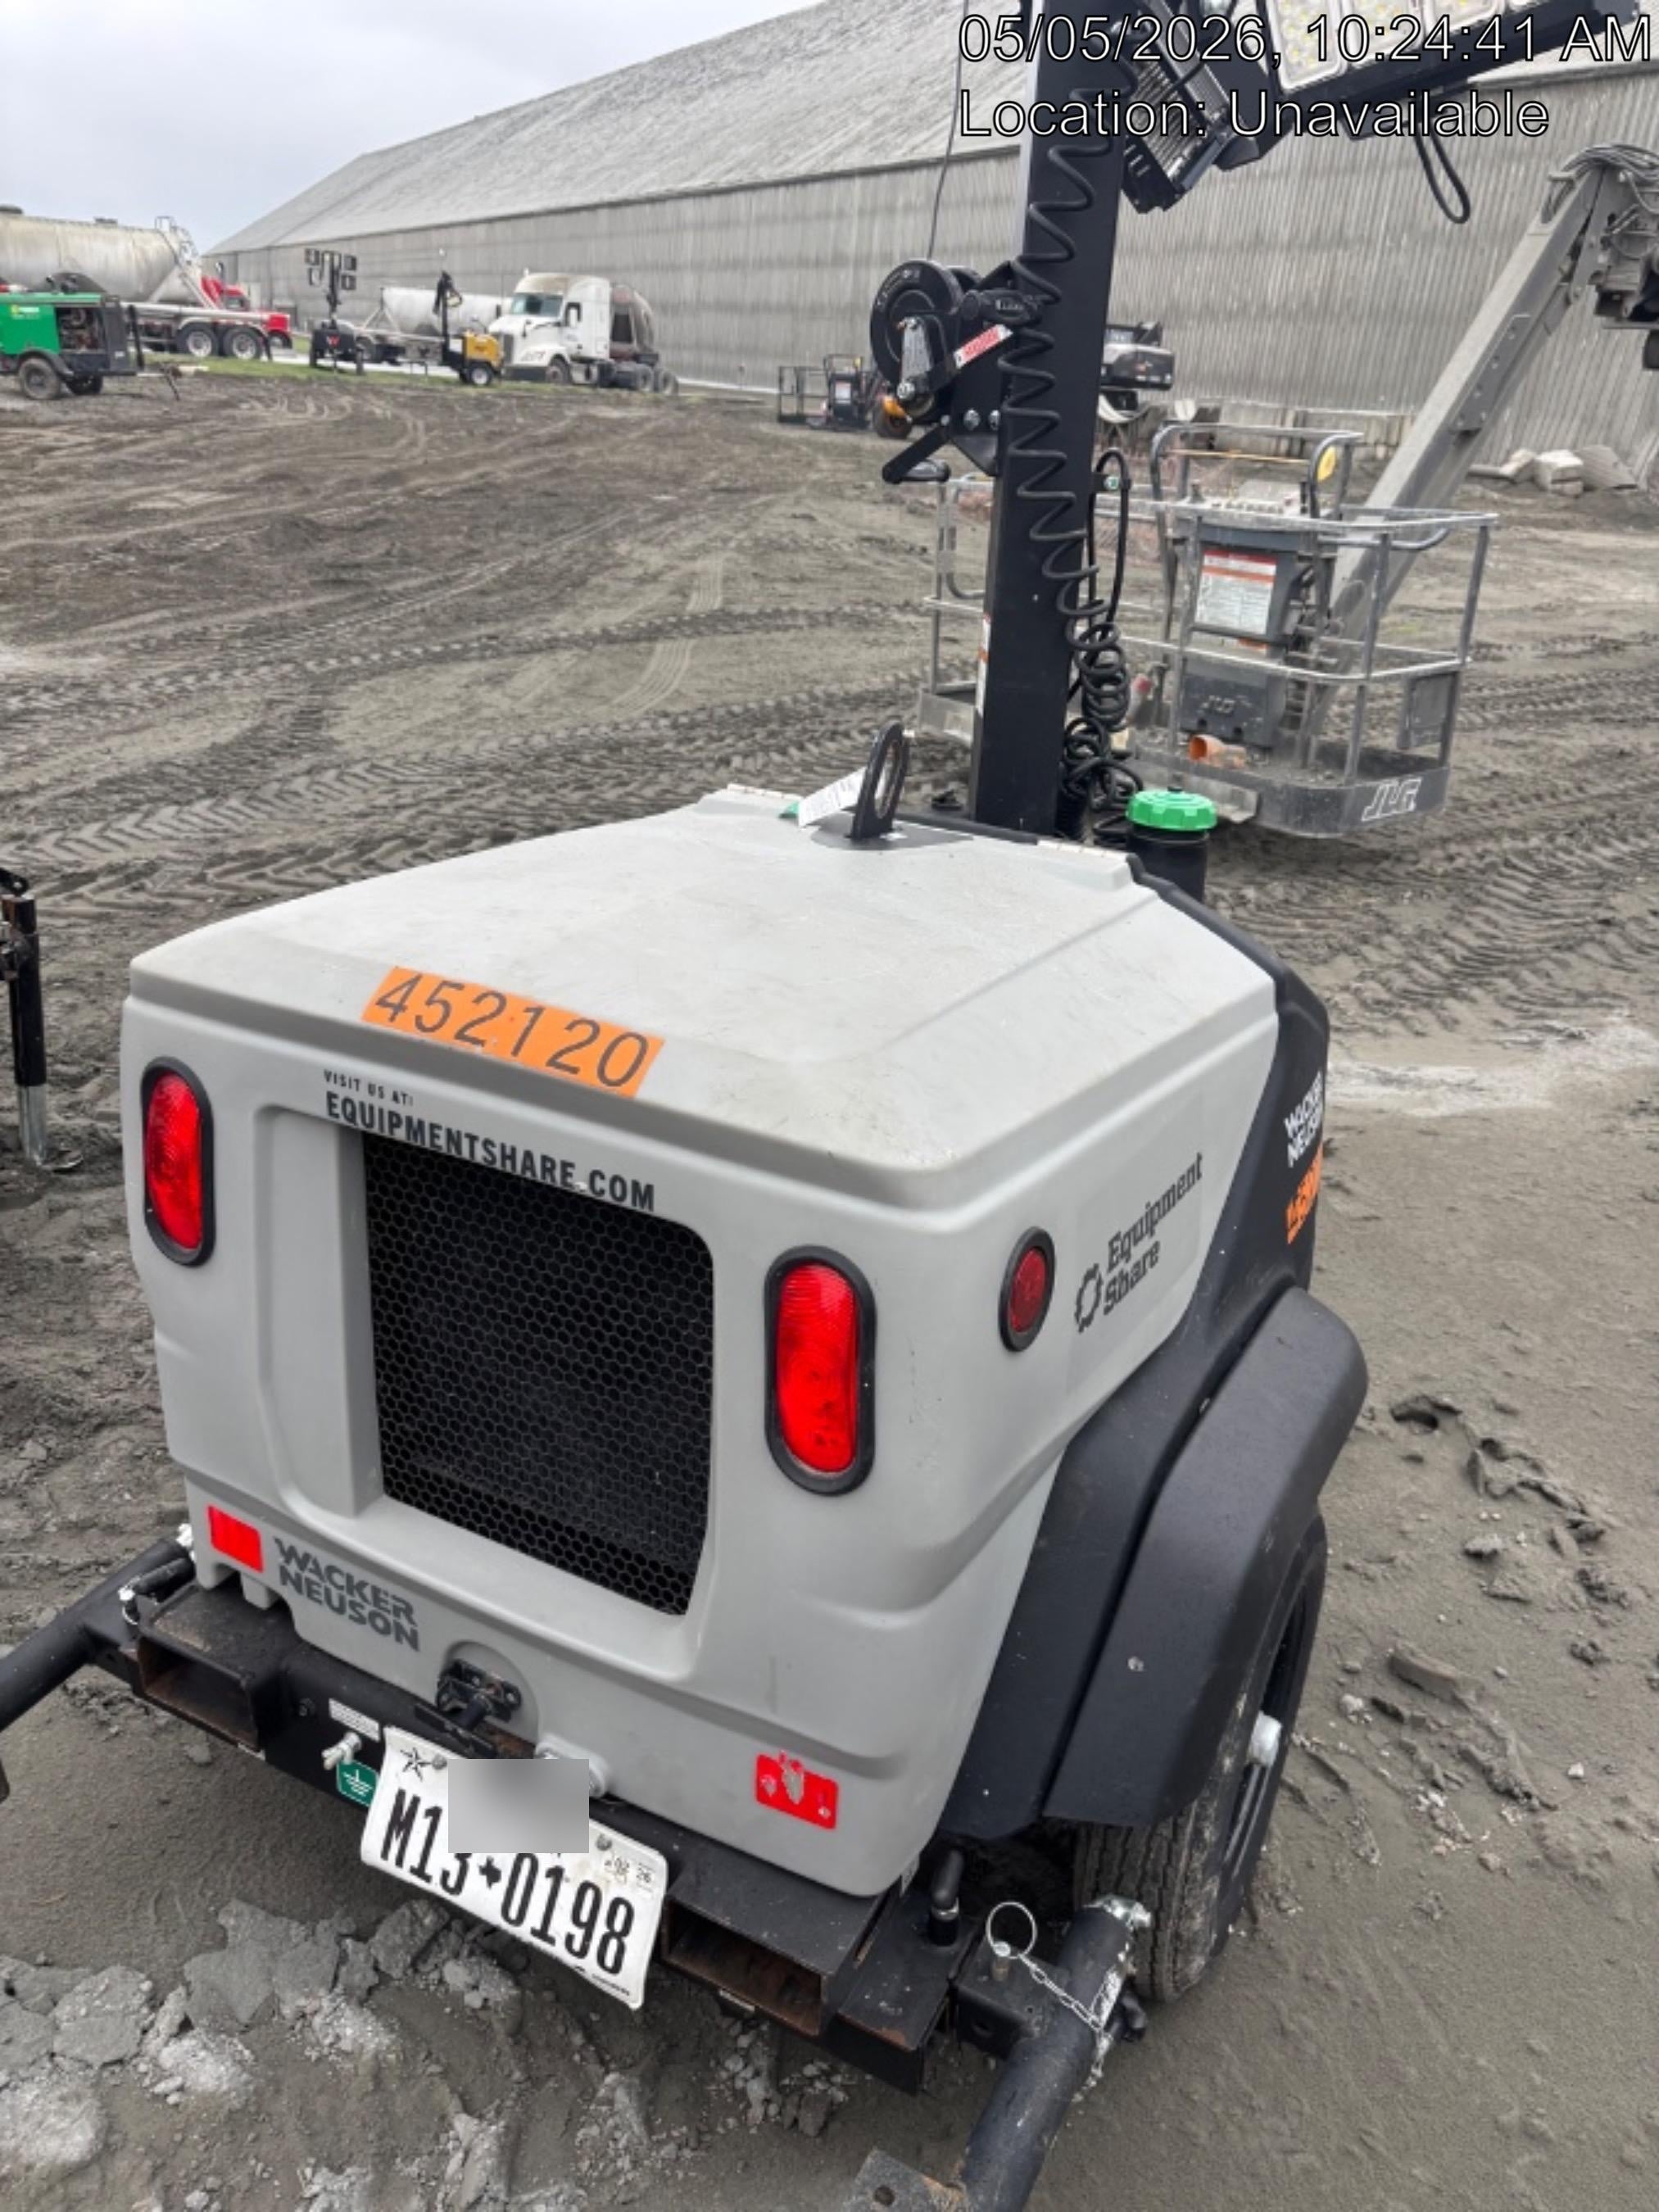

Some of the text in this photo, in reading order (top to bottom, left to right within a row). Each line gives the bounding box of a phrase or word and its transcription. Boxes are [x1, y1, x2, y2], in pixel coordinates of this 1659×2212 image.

[1361, 775, 1423, 823] JLG
[374, 972, 650, 1088] 452120
[324, 1068, 414, 1107] VISIT US AT:
[326, 1090, 655, 1213] EQUIPMENTSHARE.COM
[1106, 1151, 1203, 1274] Equipment
[1103, 1240, 1161, 1316] Share
[273, 1535, 419, 1628] WACKER
[279, 1565, 420, 1652] NEUSON
